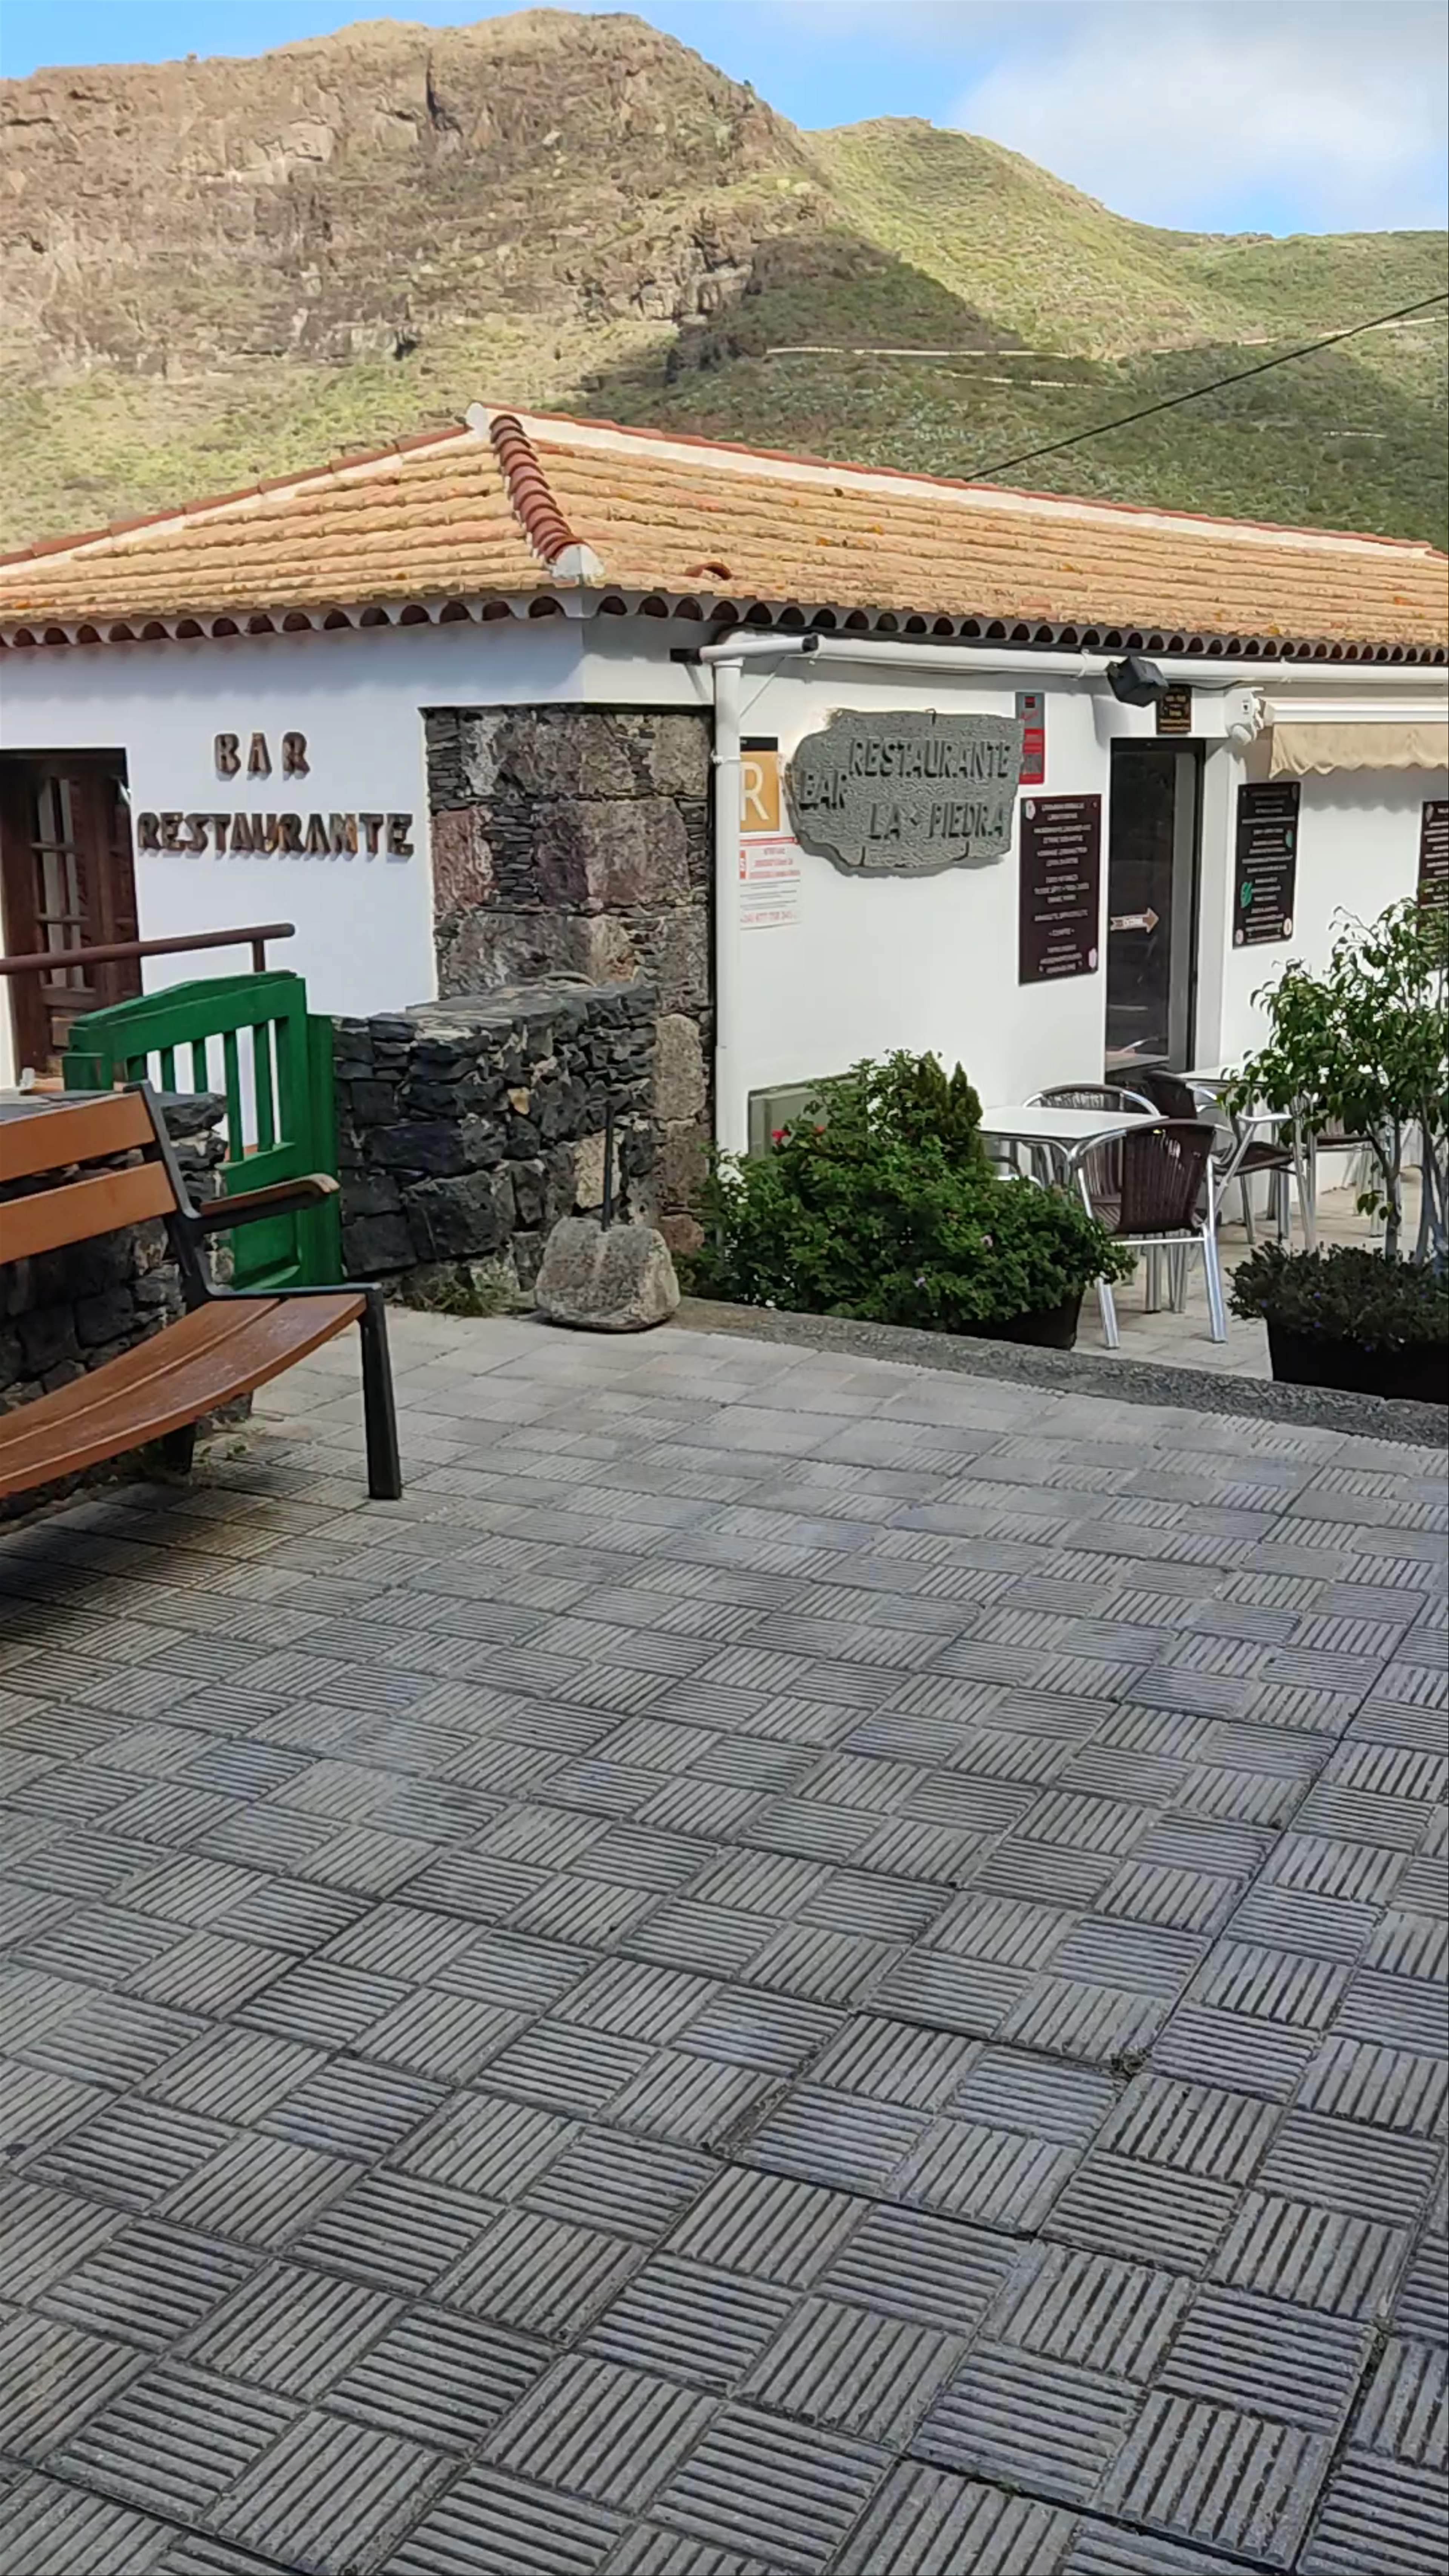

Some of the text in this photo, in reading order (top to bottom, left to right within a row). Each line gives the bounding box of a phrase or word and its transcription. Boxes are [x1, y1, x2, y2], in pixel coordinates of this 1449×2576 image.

[214, 732, 311, 775] BAR
[799, 768, 847, 810] BAR
[849, 737, 1010, 778] RESTAURANTE
[740, 761, 770, 821] R
[137, 811, 415, 857] RESTAURANTE
[868, 800, 1004, 840] LA PIEDRA
